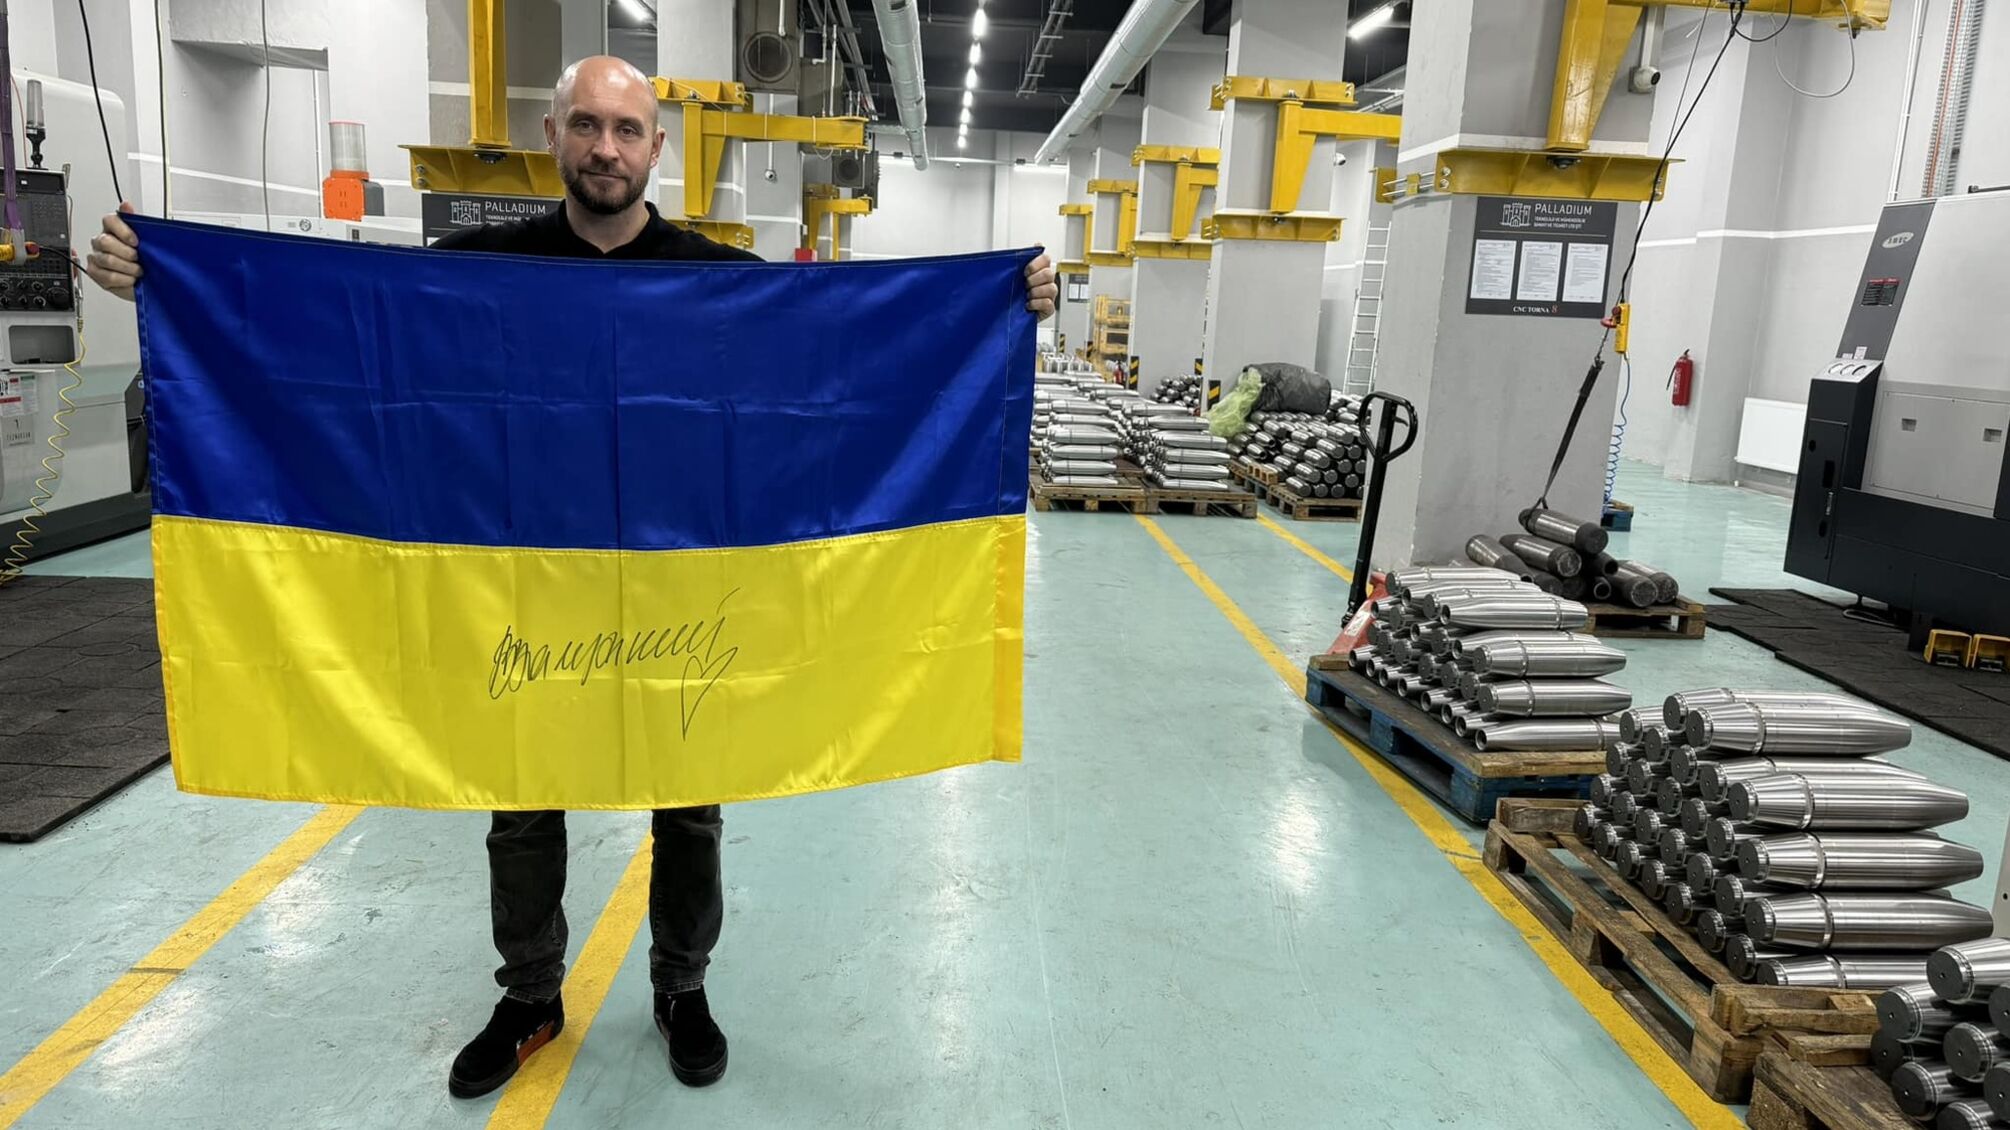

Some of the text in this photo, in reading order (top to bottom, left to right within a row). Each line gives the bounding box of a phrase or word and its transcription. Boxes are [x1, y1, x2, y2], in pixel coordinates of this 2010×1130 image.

[485, 201, 546, 215] PALLADIUM
[1534, 203, 1592, 215] PALLADIUM
[1513, 305, 1527, 313] CNC
[1528, 306, 1549, 314] TORNA
